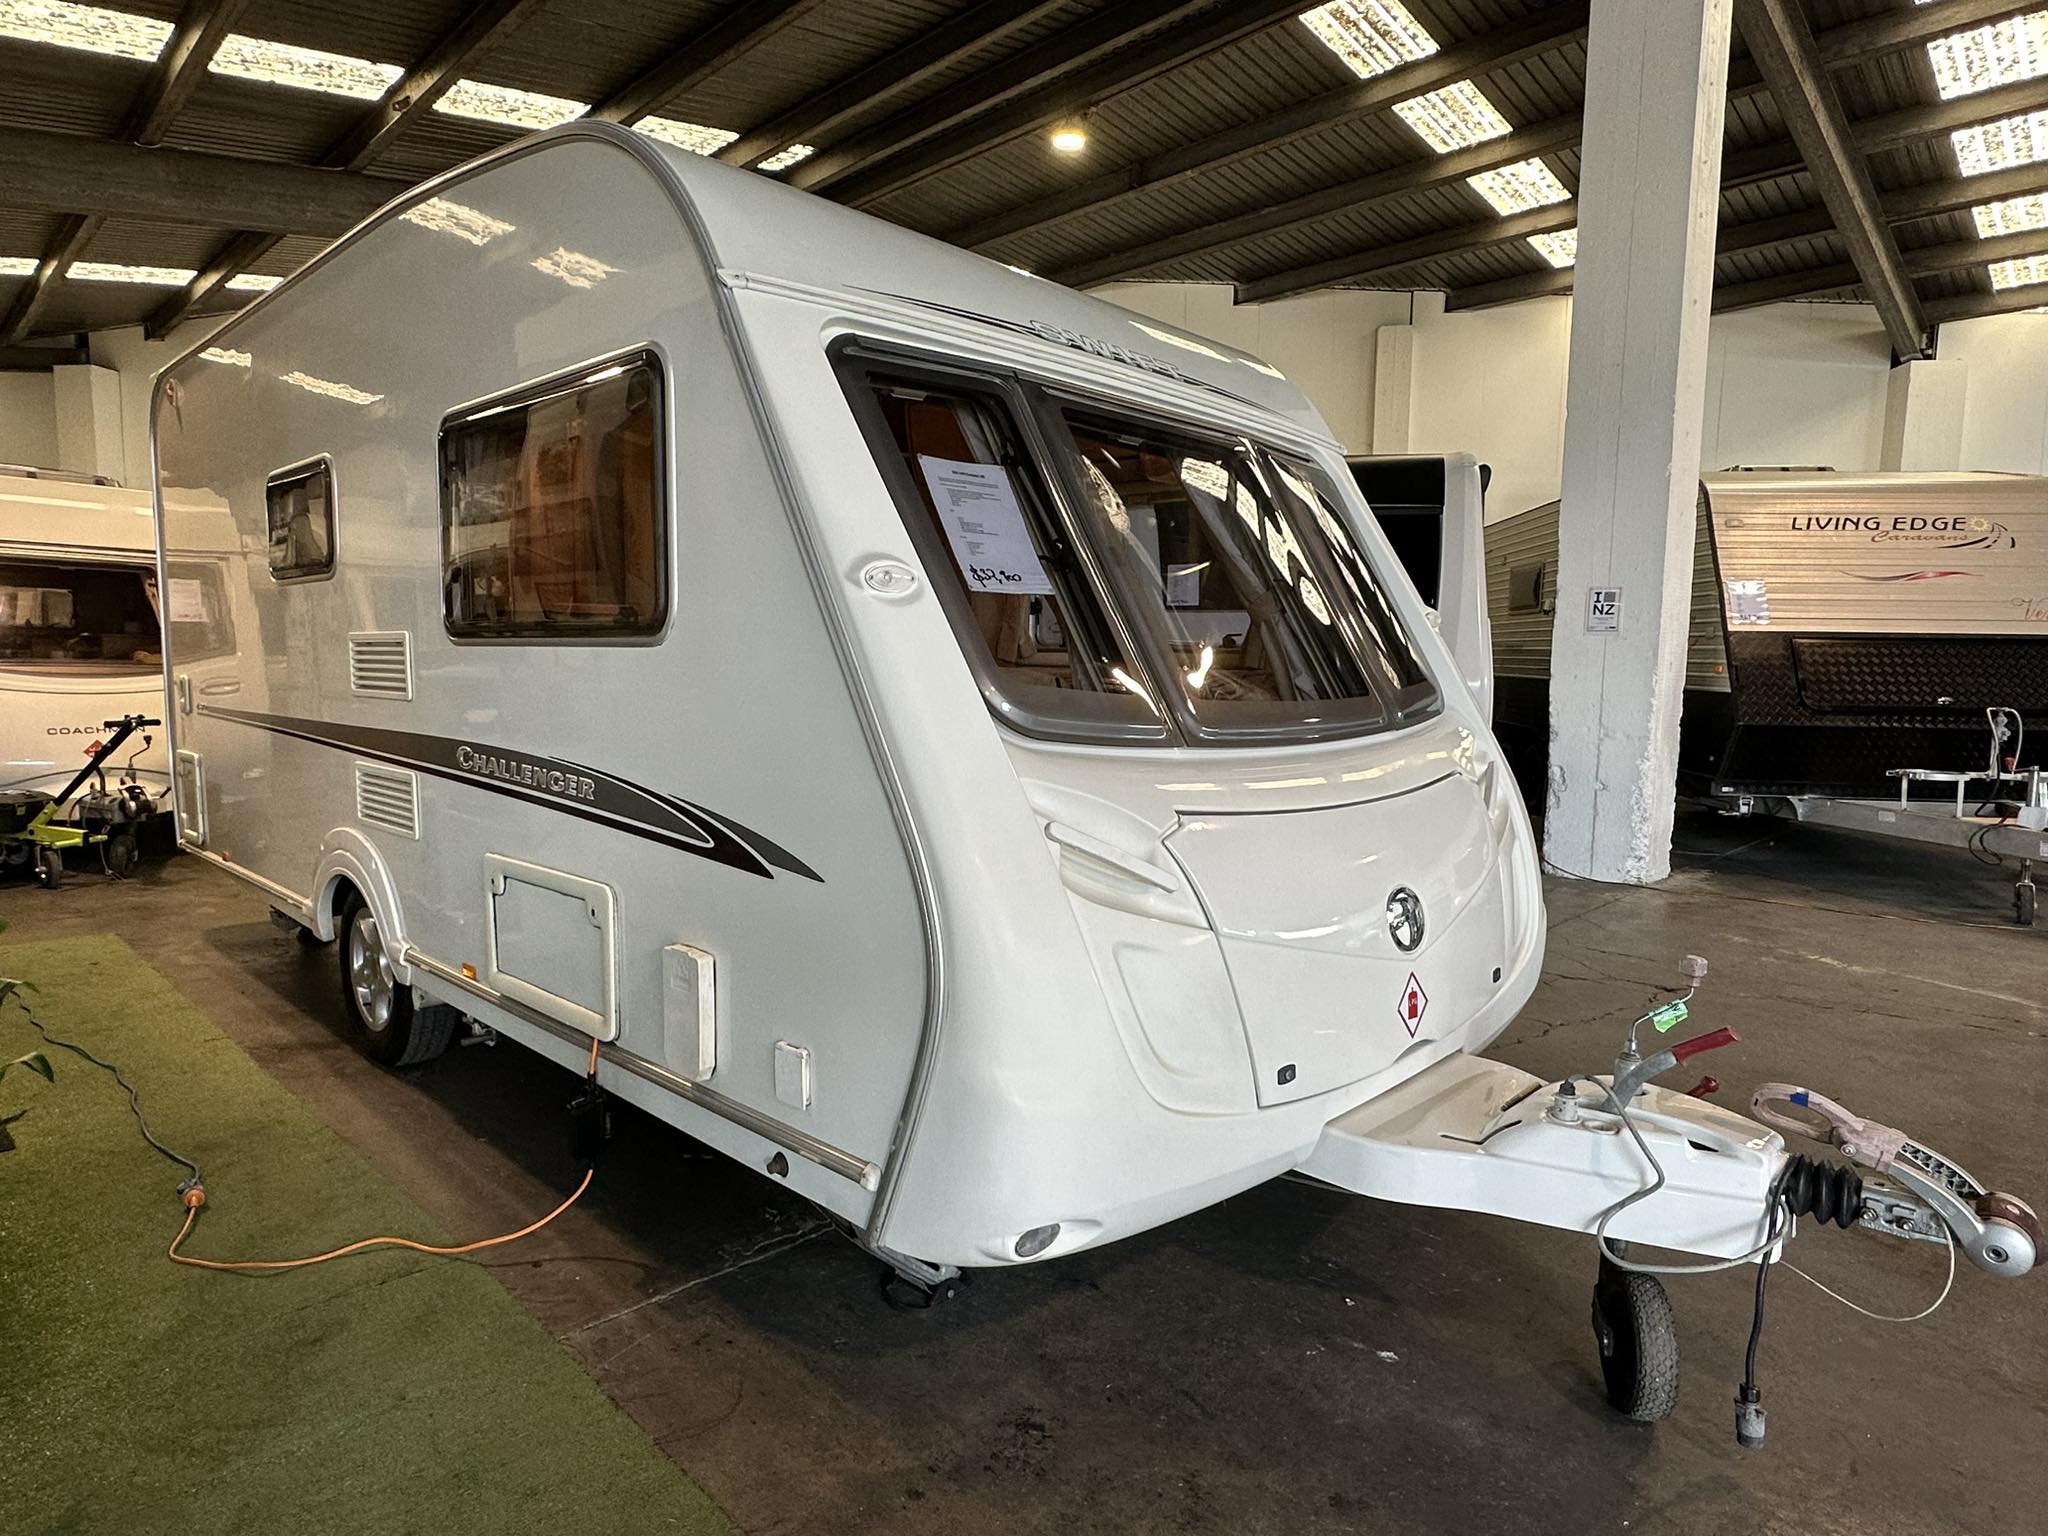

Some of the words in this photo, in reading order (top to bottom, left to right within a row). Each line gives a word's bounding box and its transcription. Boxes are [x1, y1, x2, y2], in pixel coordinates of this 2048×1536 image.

[1791, 517, 1880, 531] LIVING
[1892, 517, 1967, 531] EDGE
[1871, 530, 1968, 543] Caravans
[1593, 604, 1615, 616] NZ
[456, 745, 596, 800] CHALLENGER
